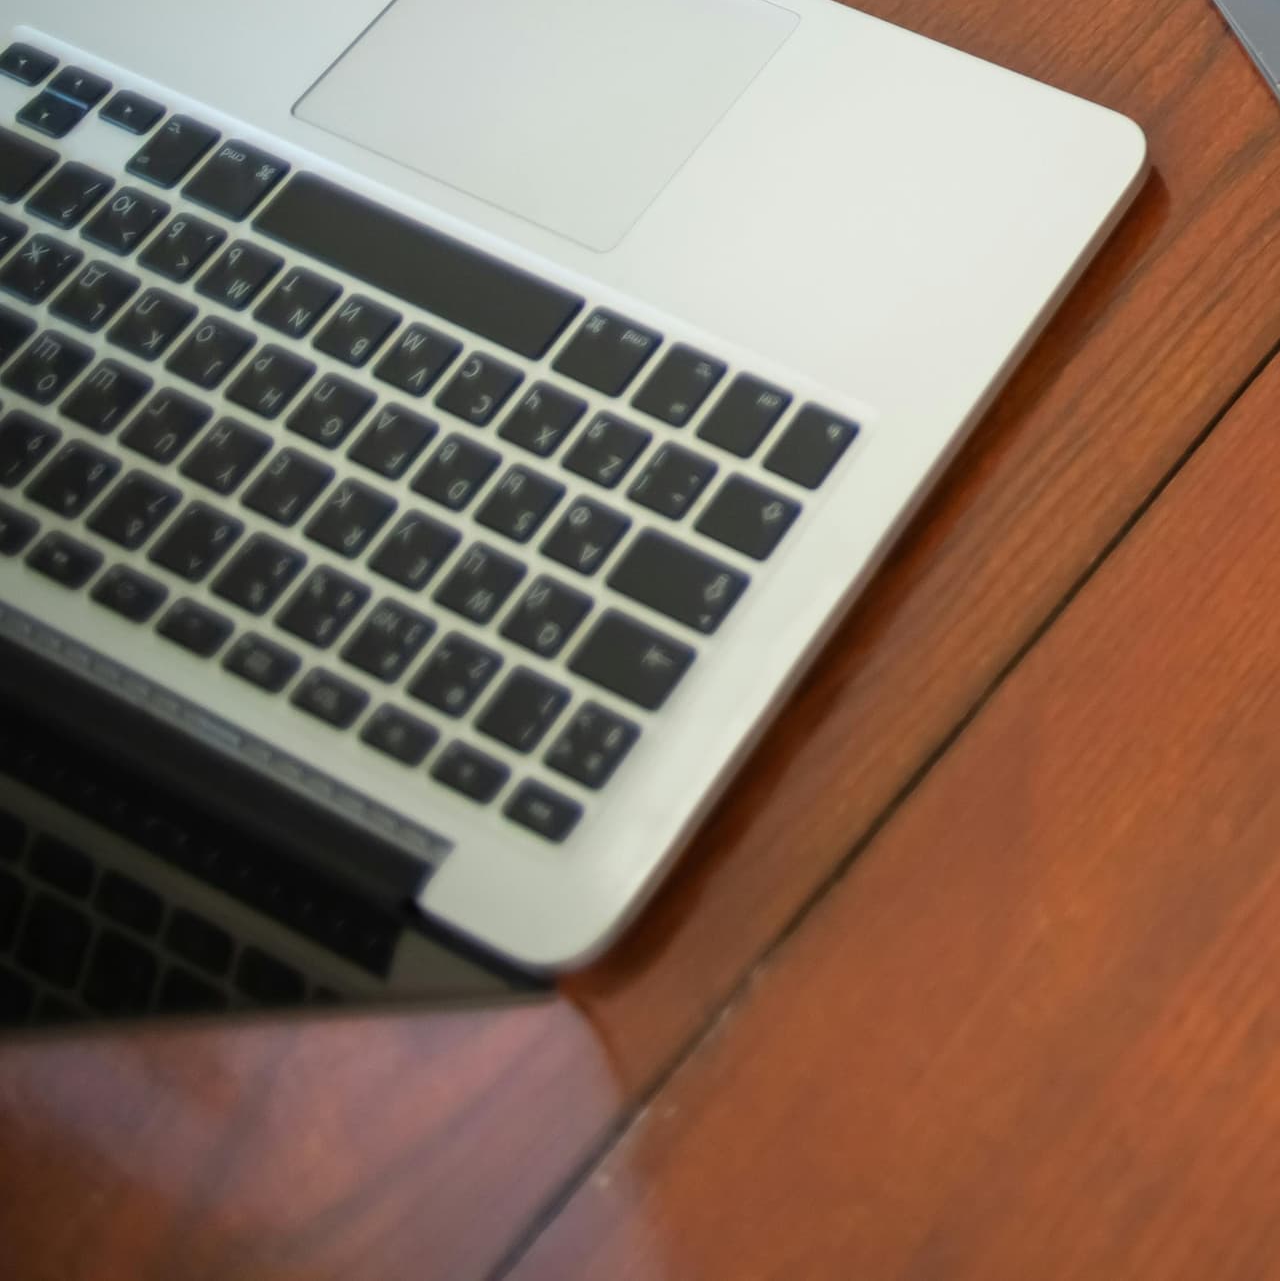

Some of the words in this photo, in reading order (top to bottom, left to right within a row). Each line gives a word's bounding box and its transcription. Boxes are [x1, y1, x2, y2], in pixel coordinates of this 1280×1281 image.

[219, 146, 245, 162] cmd
[110, 196, 136, 215] Ю
[288, 309, 311, 330] N
